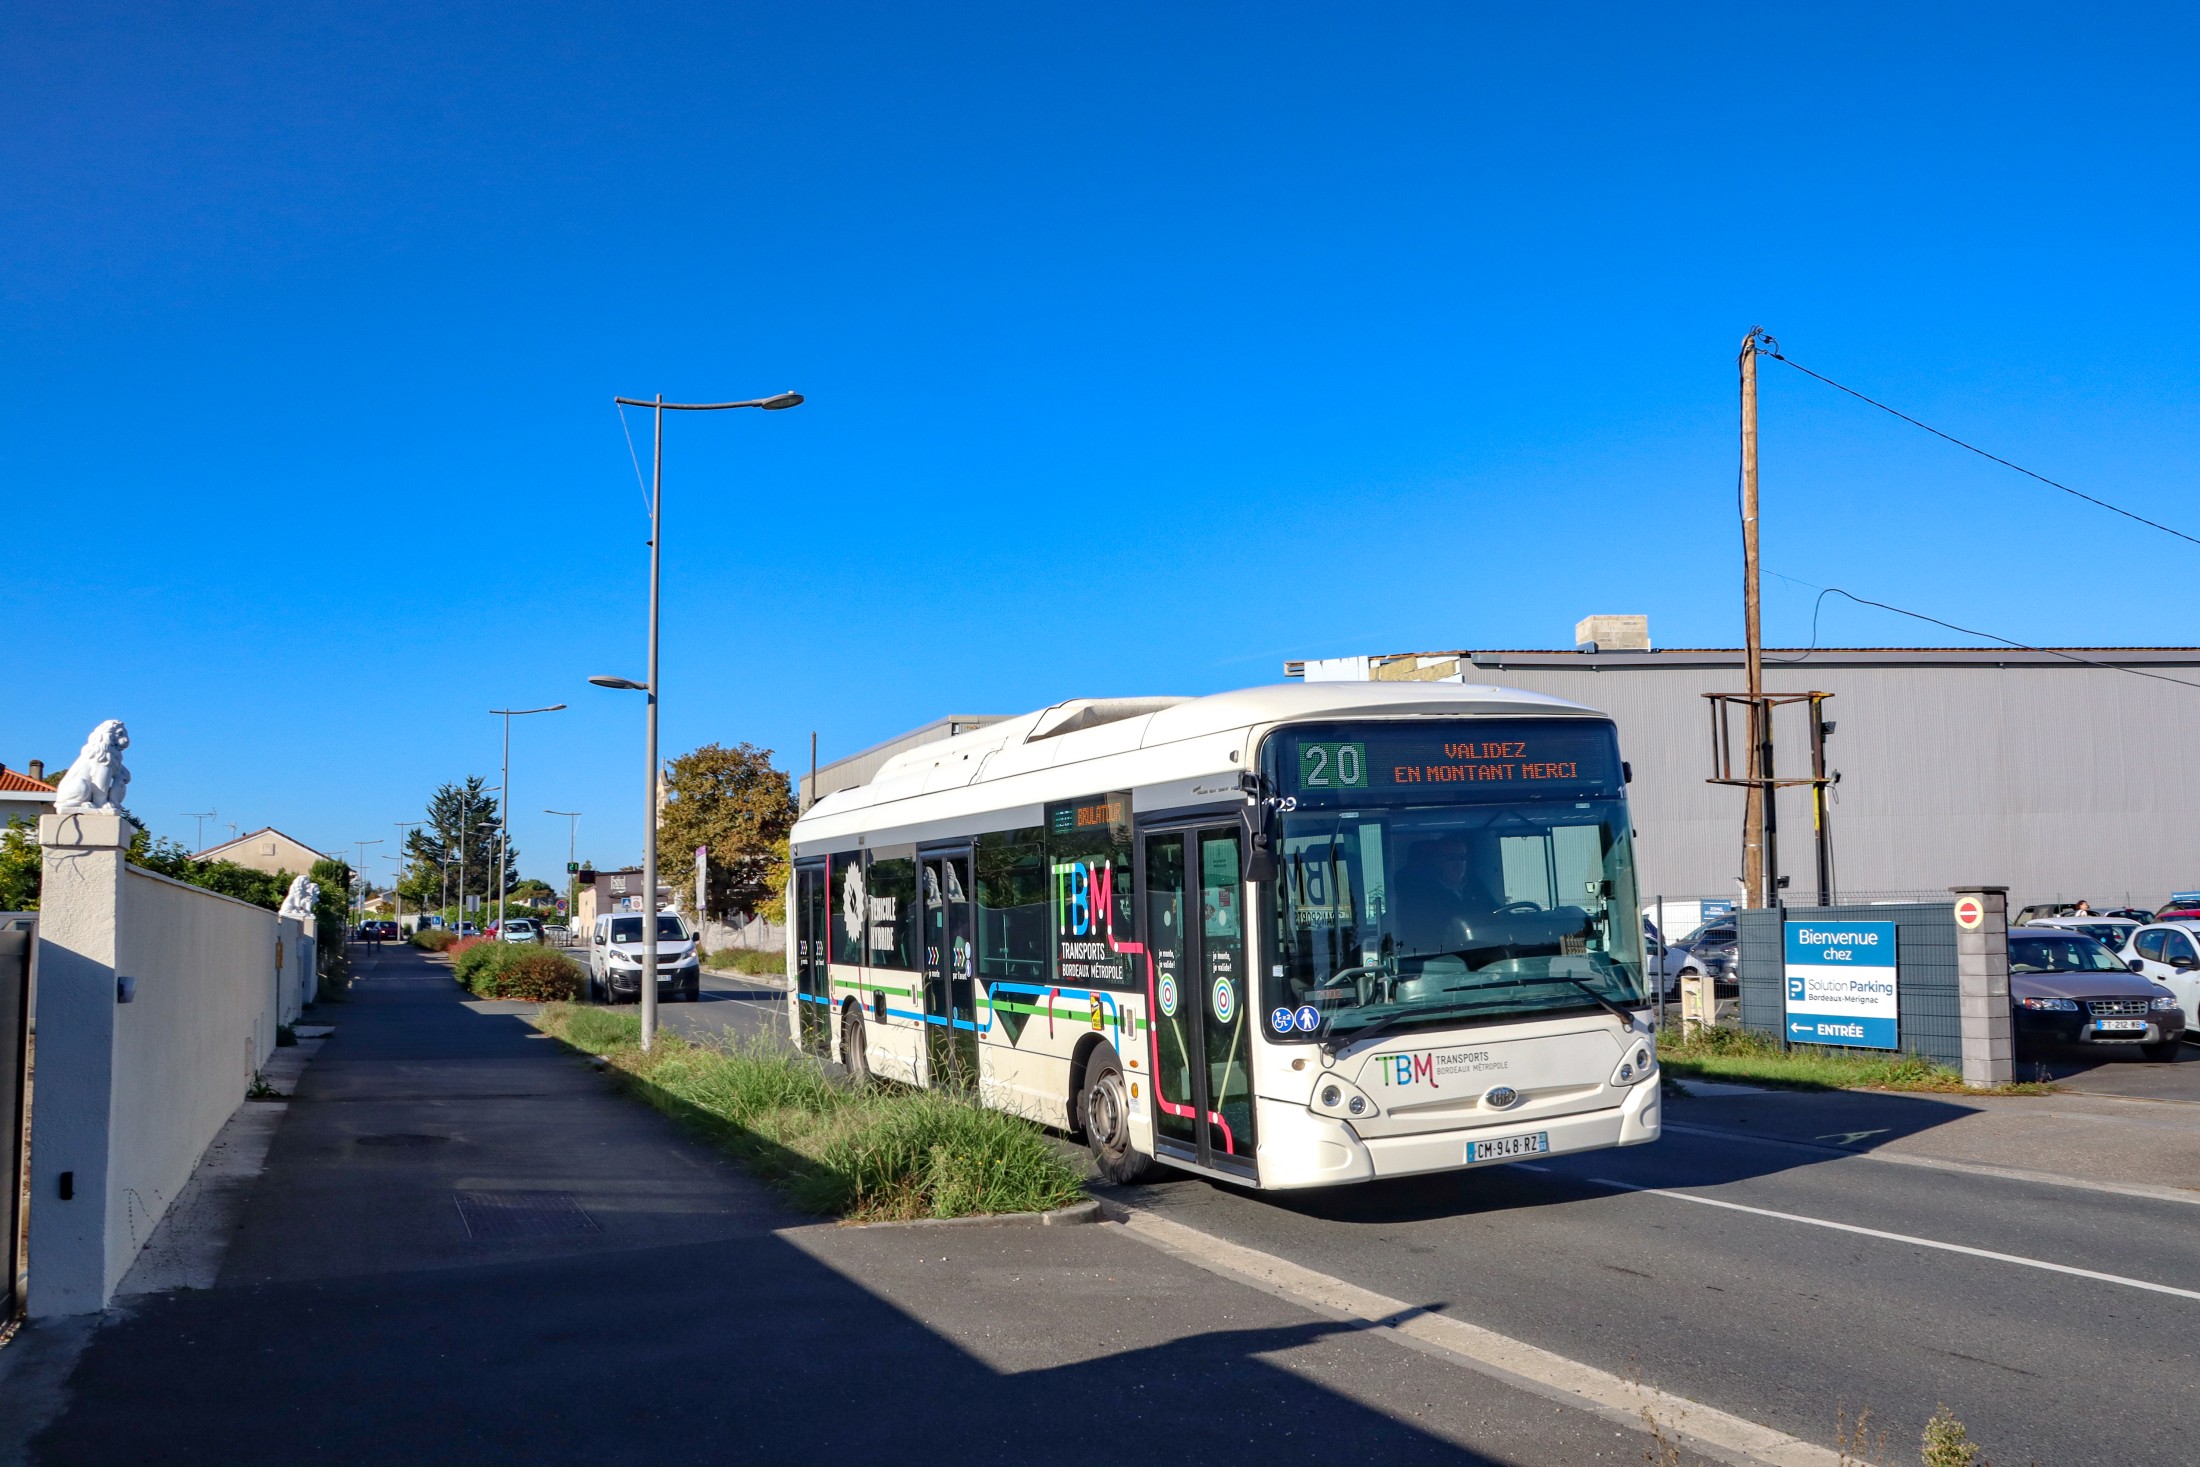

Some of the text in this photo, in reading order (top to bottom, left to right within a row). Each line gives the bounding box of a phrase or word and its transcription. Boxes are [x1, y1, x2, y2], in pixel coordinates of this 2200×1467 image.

[1443, 742, 1527, 759] VALIDEZ
[1305, 745, 1361, 785] 20
[1394, 762, 1578, 783] EN MONTANT MERCI
[1051, 859, 1113, 936] TBM
[870, 926, 895, 951] HYBRIDE
[1799, 929, 1878, 945] Bienvenue
[1062, 942, 1105, 961] TRANSPORTS
[1823, 947, 1852, 960] chez
[1062, 962, 1123, 979] BORDEAUX MÉTROPOLE
[1808, 979, 1893, 996] Solution Parking
[1808, 994, 1879, 1004] Bordeaux-Mérignac
[1817, 1023, 1864, 1038] ENTRÉE
[1436, 1051, 1489, 1066] TRANSPORTS
[1375, 1052, 1439, 1089] TBM
[1436, 1061, 1508, 1076] BORDEAUX MÉTROPOLE
[1478, 1136, 1537, 1159] CM-948-RZ
